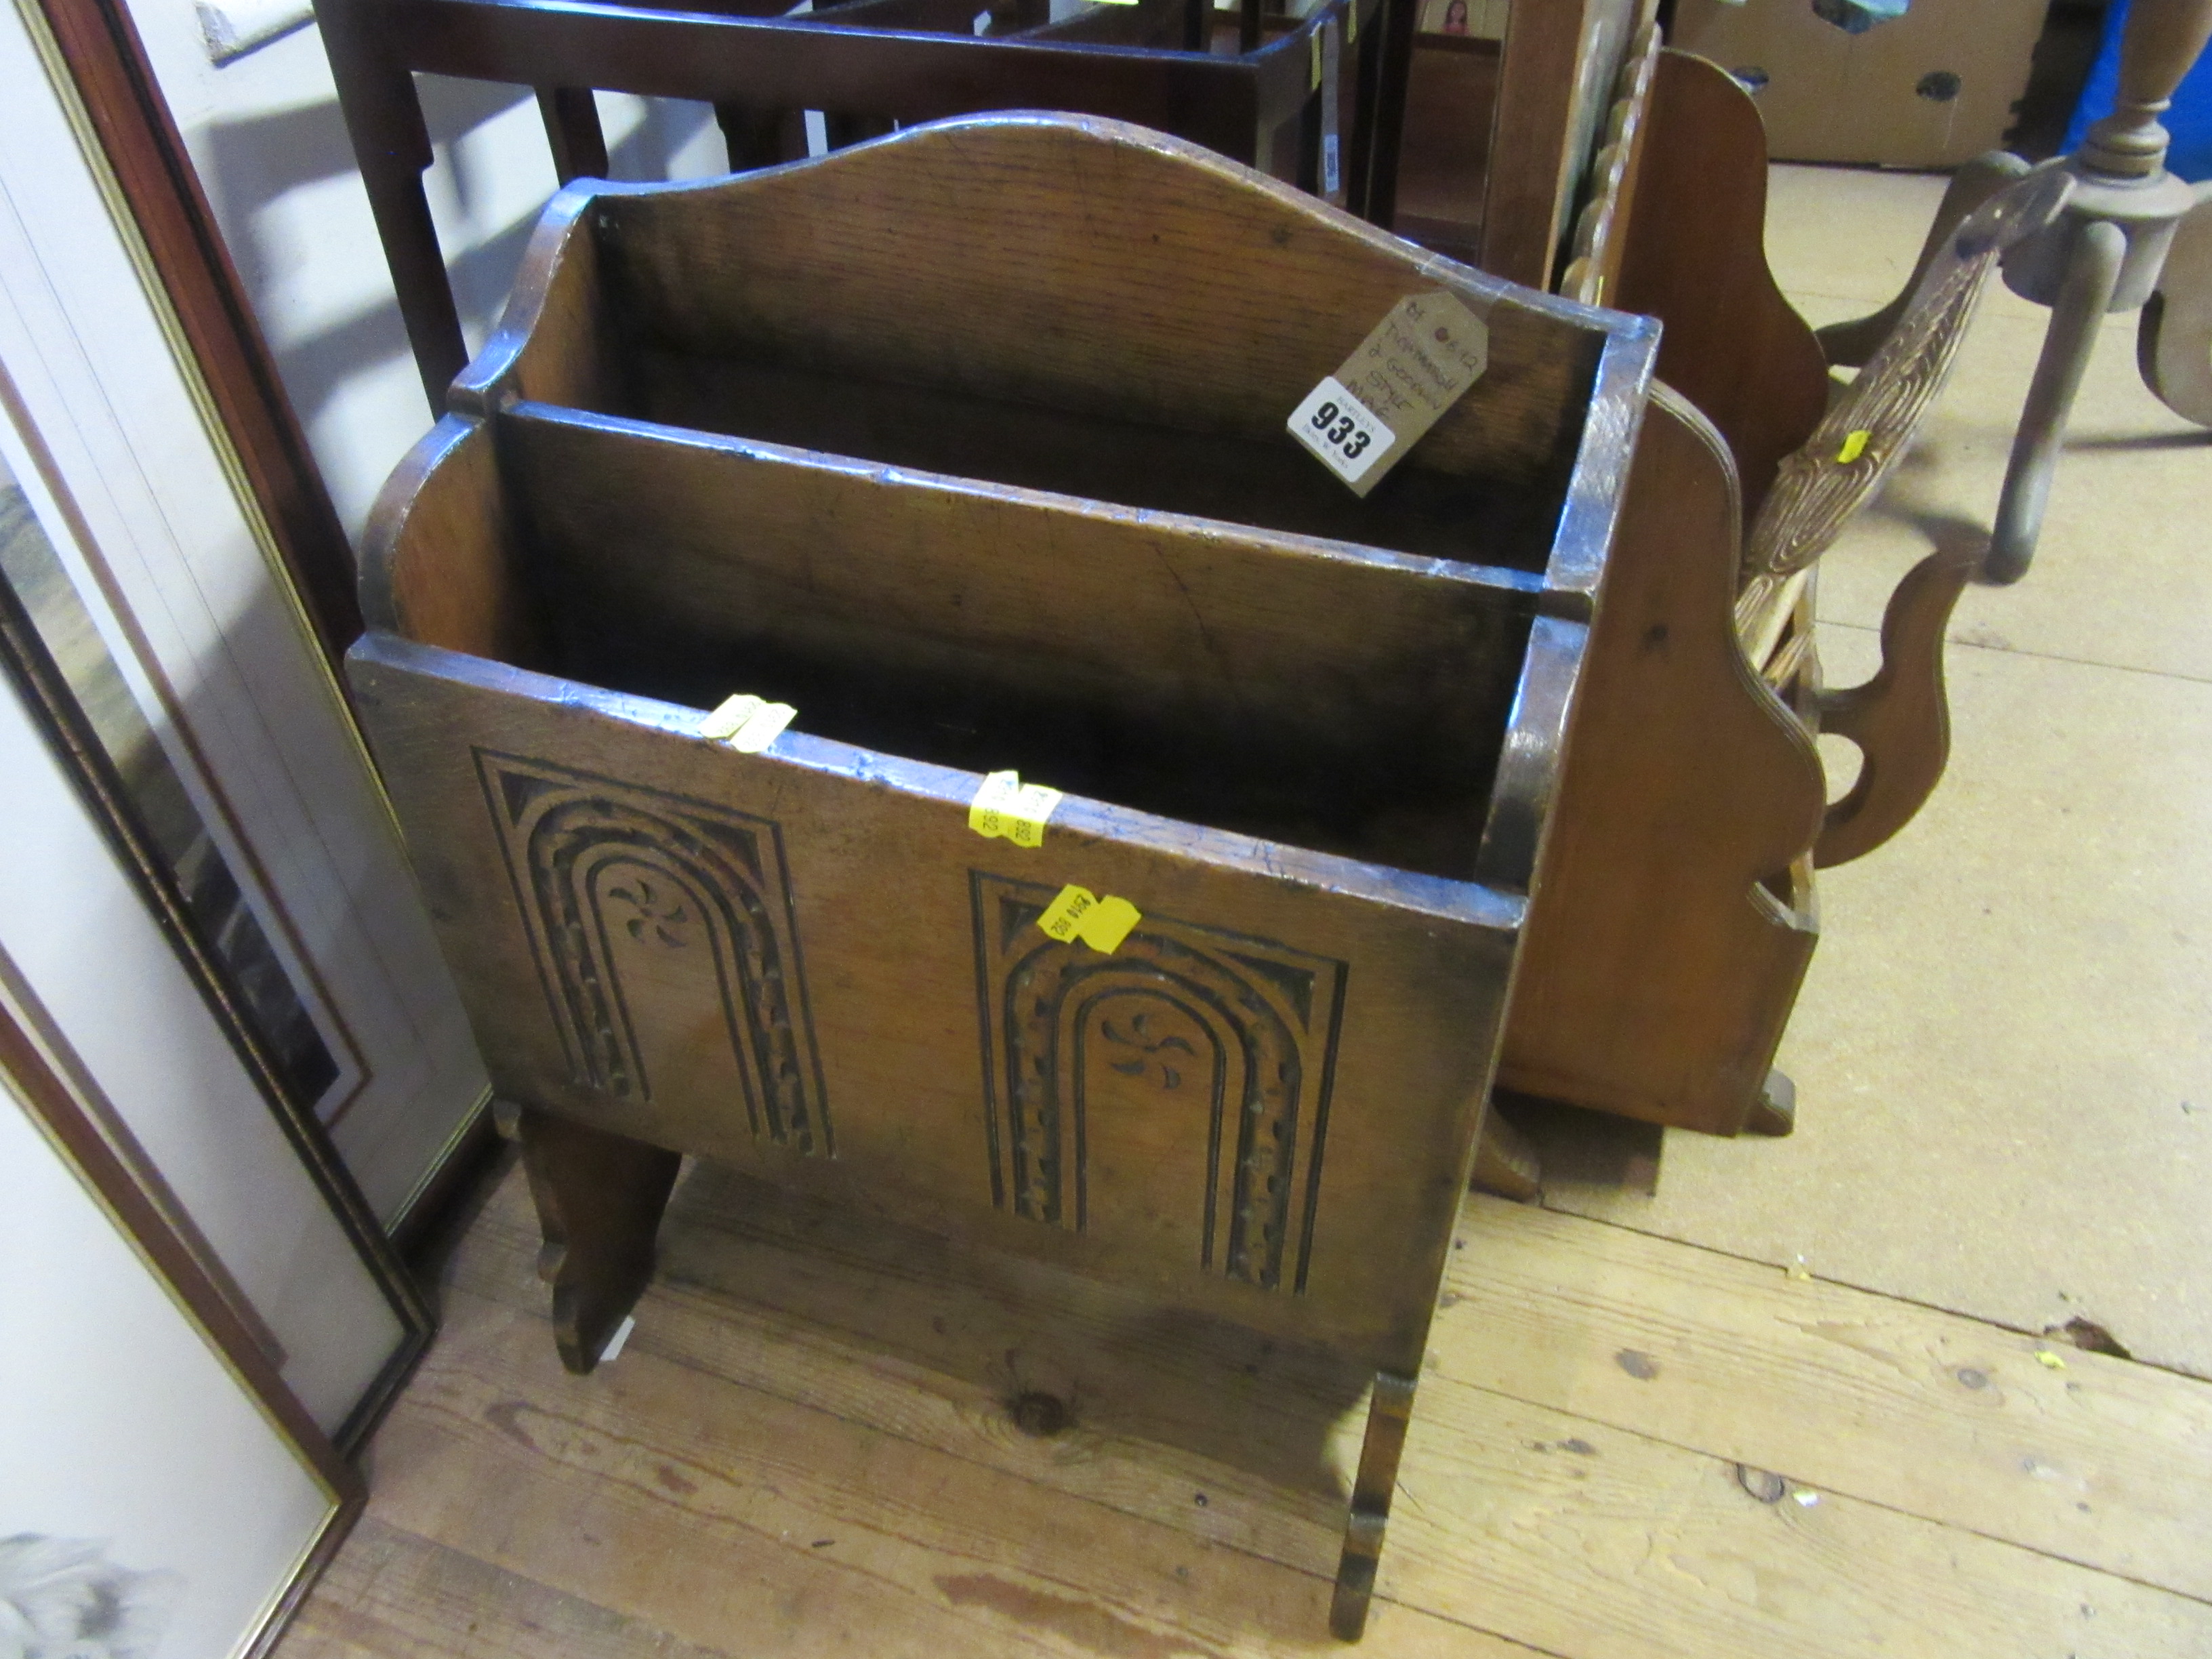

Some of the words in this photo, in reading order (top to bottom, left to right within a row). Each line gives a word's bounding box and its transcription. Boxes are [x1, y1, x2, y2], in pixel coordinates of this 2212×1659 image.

[1311, 401, 1371, 459] 933
[983, 808, 1000, 831] 892
[1015, 820, 1031, 841] 892
